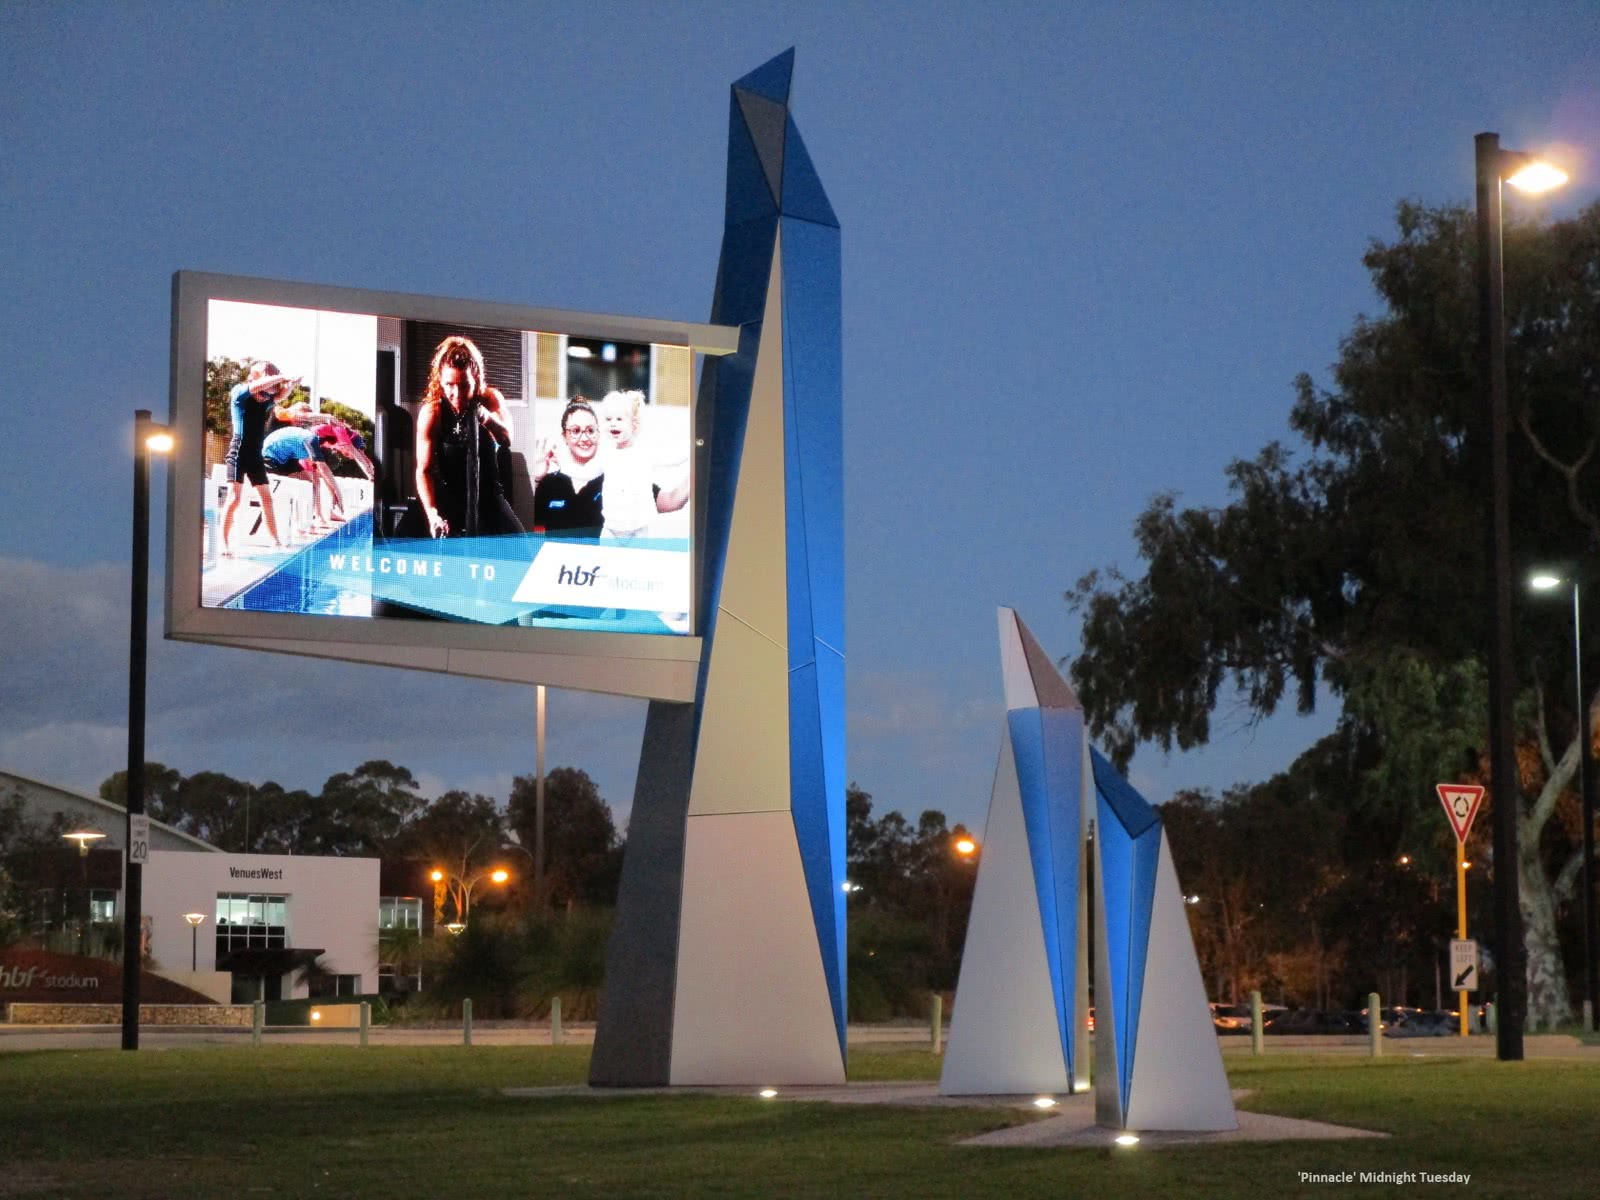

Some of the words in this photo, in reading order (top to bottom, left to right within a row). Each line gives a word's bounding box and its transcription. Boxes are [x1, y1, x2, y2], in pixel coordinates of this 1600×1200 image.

[329, 554, 443, 577] WELCOME
[469, 563, 496, 581] TO
[558, 564, 600, 587] hbf
[132, 841, 147, 859] 20
[229, 866, 283, 880] VenuesWest
[1455, 944, 1473, 953] KEEP
[45, 974, 98, 988] stadium
